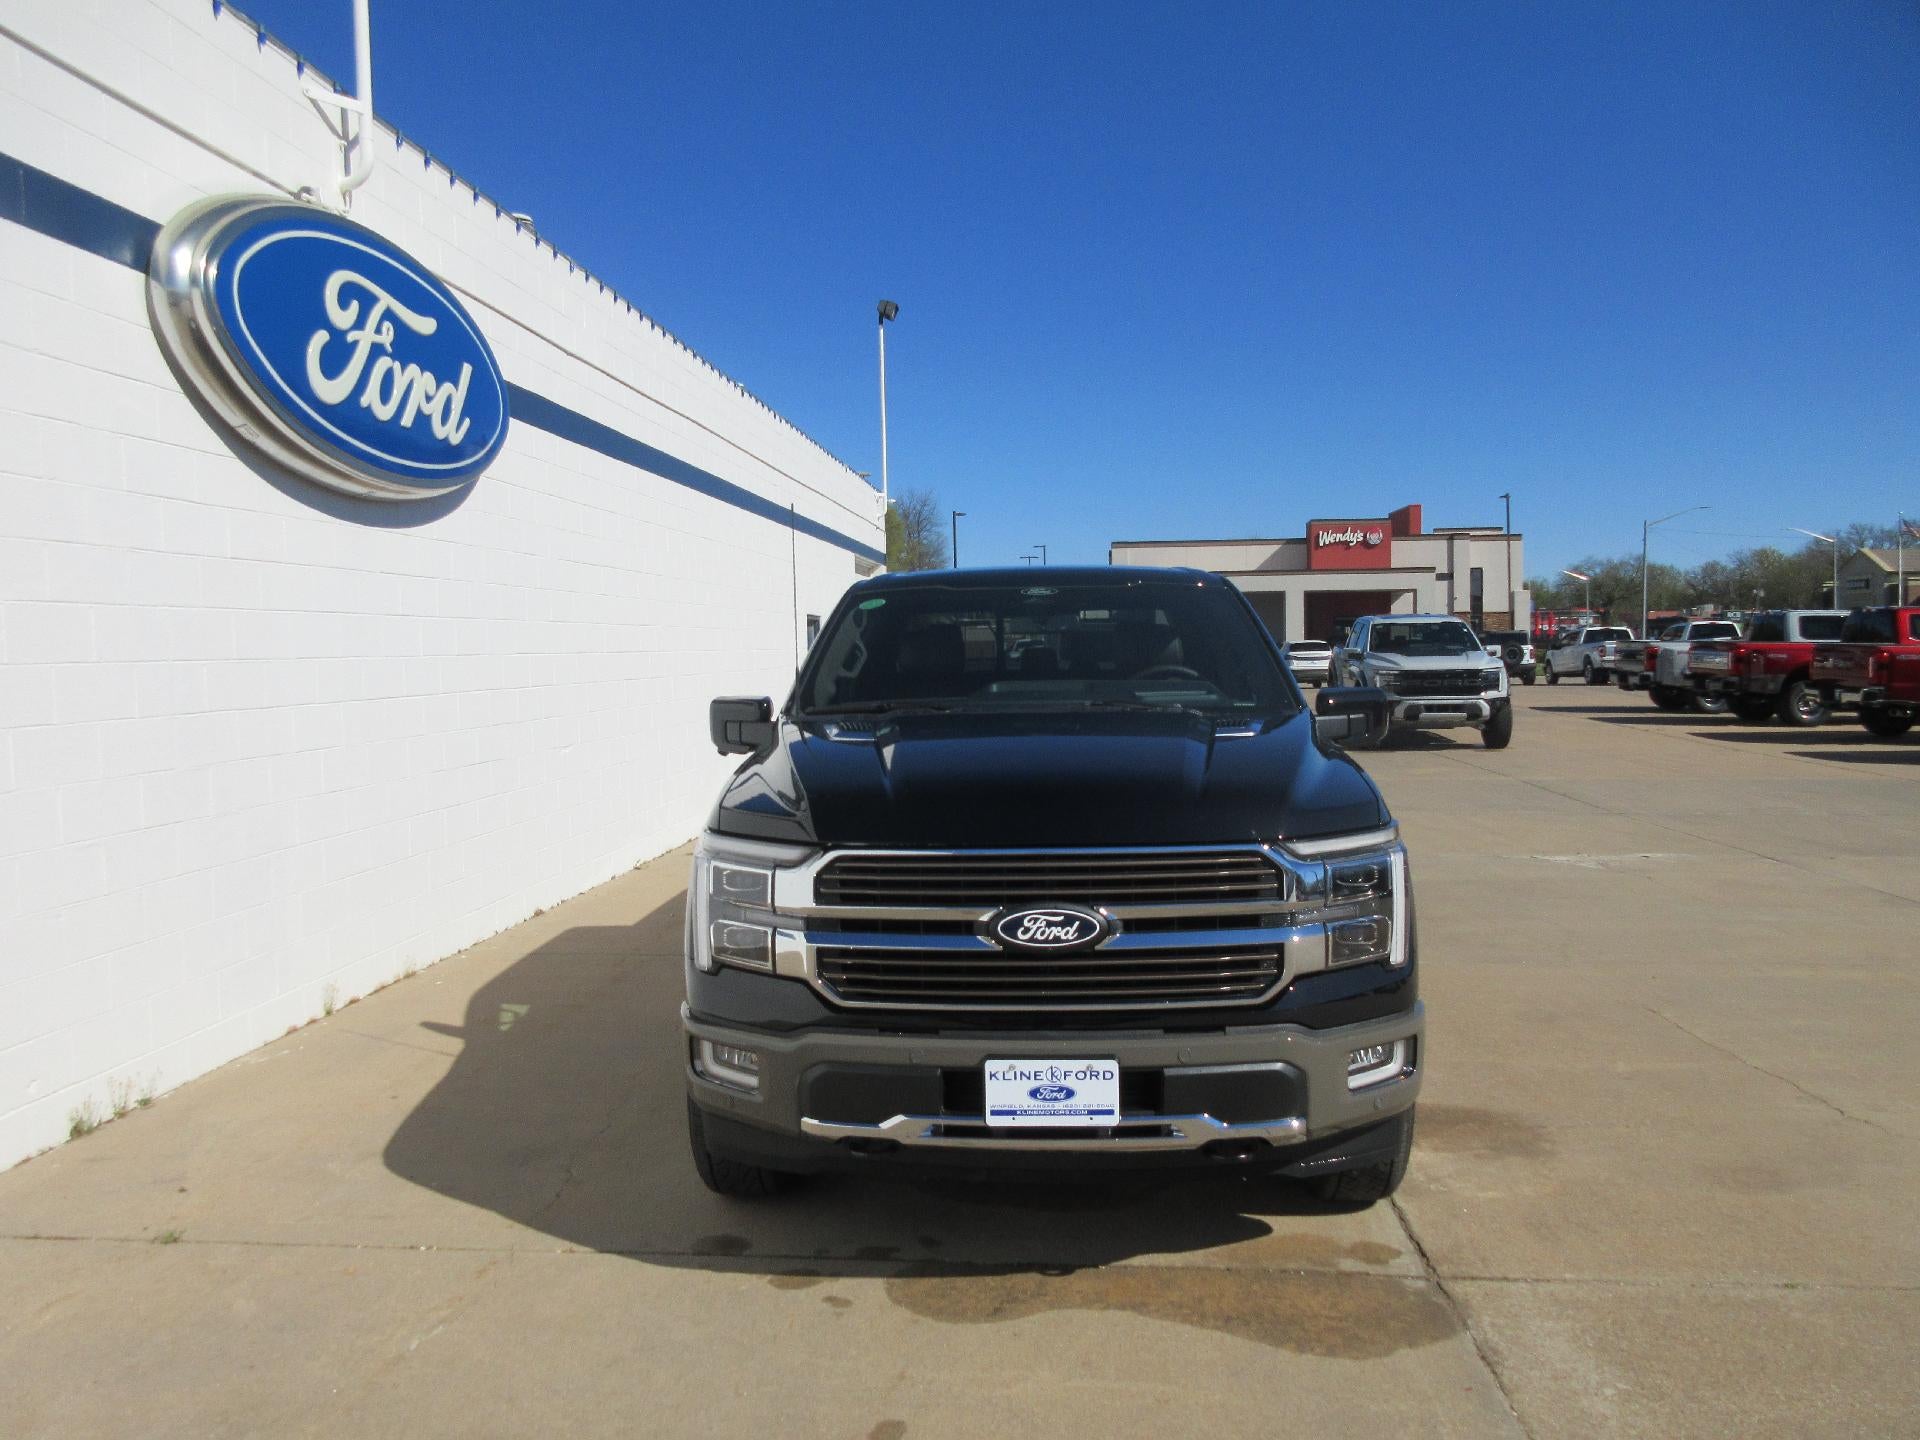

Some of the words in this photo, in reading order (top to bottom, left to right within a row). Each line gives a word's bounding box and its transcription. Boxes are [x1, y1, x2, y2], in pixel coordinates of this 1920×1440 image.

[306, 270, 473, 446] Ford
[1318, 526, 1364, 547] Wendy's
[1017, 914, 1080, 940] Ford
[989, 1070, 1043, 1081] KLINE
[1063, 1070, 1114, 1081] FORD
[1036, 1086, 1067, 1100] Ford
